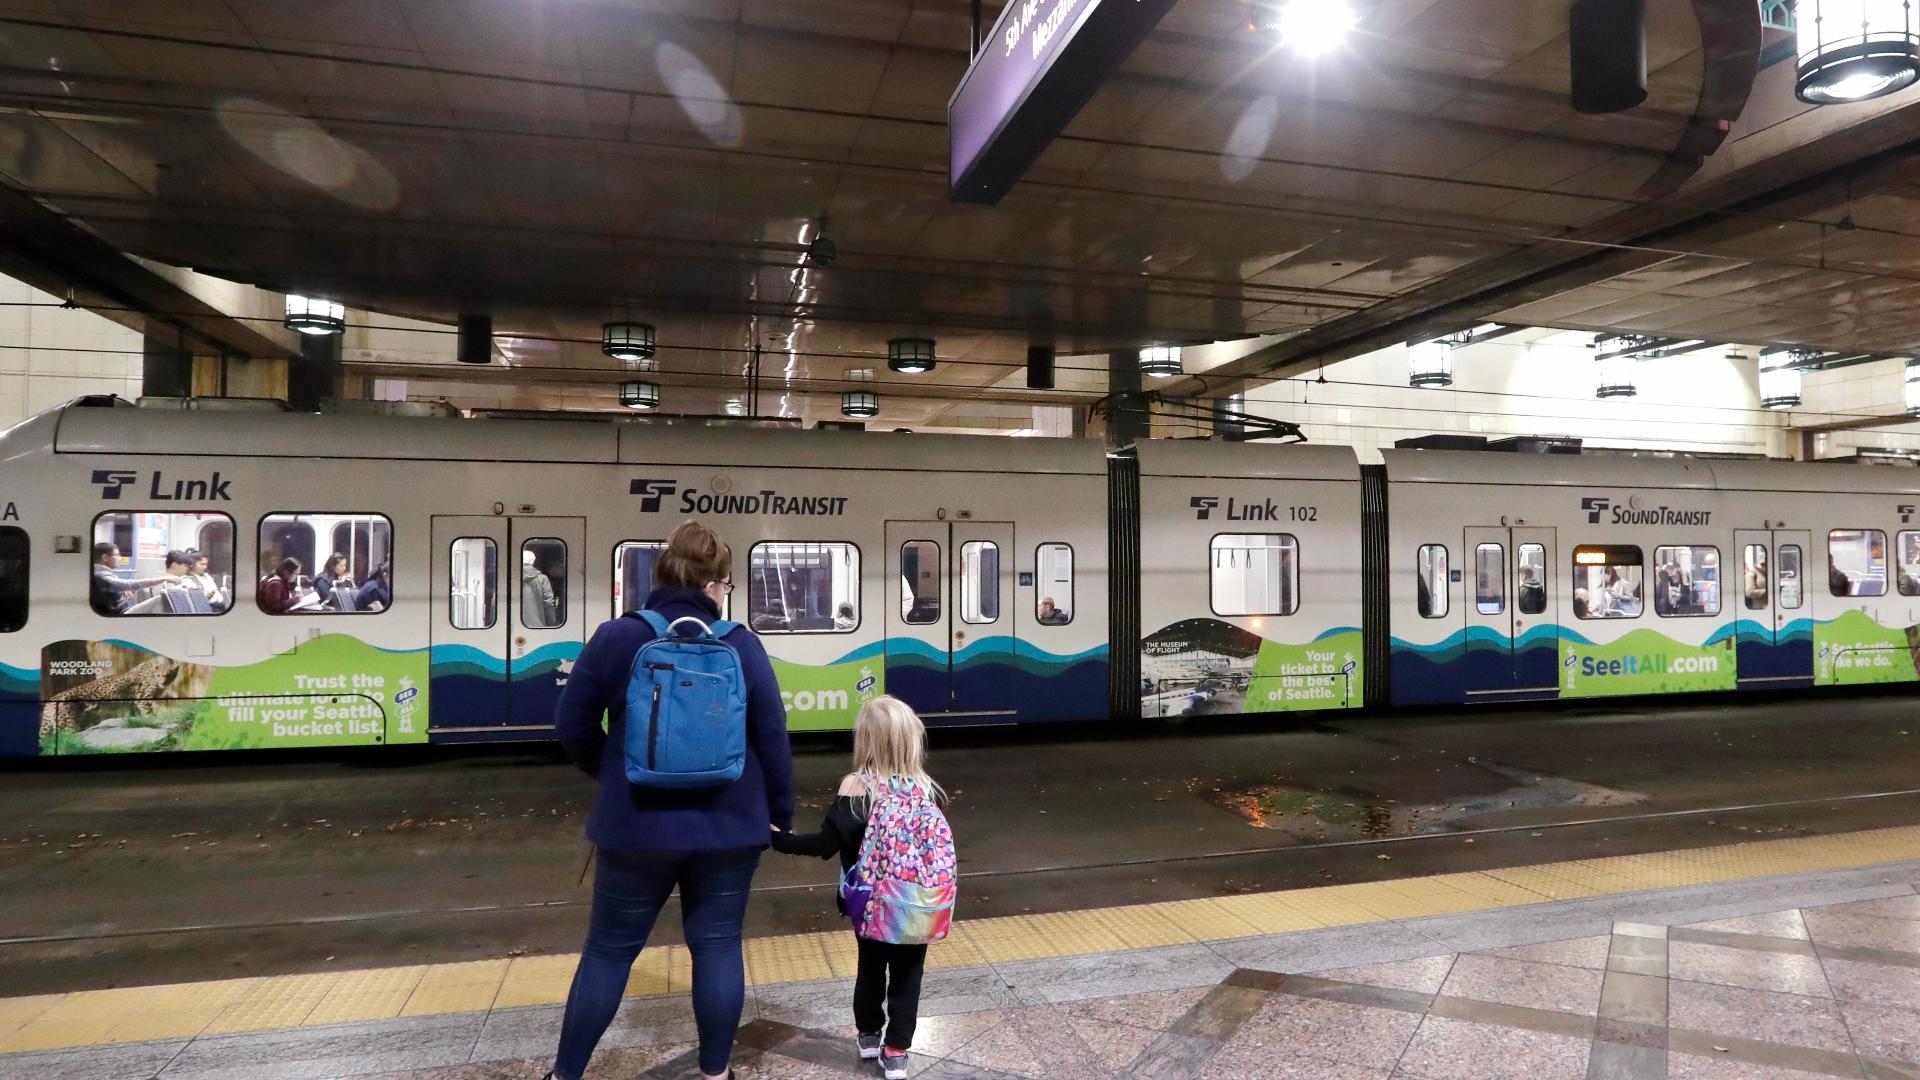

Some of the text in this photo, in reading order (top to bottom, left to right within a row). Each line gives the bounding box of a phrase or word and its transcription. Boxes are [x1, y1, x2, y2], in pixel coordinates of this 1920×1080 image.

[1006, 17, 1020, 57] 5th
[149, 471, 232, 500] Link
[1227, 497, 1278, 520] Link
[1289, 506, 1318, 521] 102
[1305, 650, 1336, 661] Your
[50, 660, 113, 669] WOODLAND
[50, 667, 103, 676] PARK ZOO
[1281, 663, 1335, 675] ticket to
[1582, 653, 1718, 676] SeeItAll.com
[294, 673, 385, 689] Trust the
[1282, 675, 1303, 688] the
[217, 689, 385, 706] ultimate local to
[1268, 687, 1335, 701] of Seattle.
[228, 704, 384, 724] fill your Seattle
[272, 720, 385, 737] bucket list.
